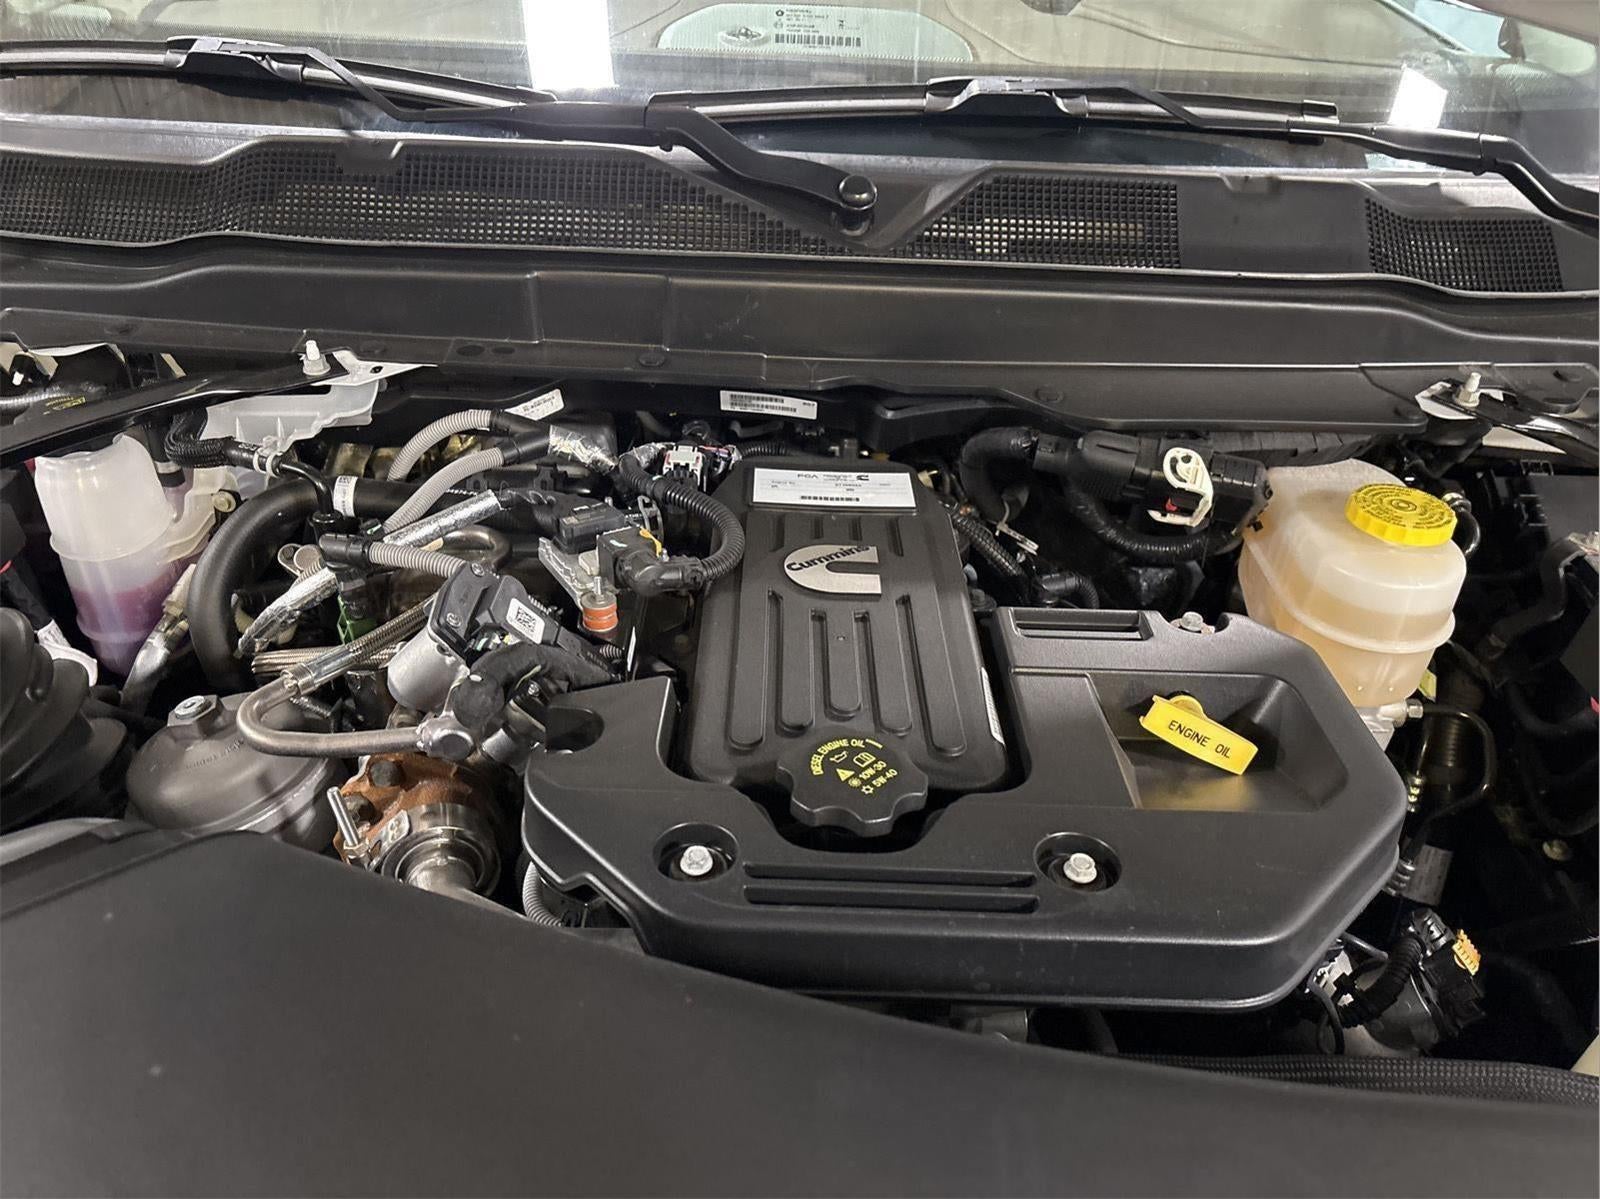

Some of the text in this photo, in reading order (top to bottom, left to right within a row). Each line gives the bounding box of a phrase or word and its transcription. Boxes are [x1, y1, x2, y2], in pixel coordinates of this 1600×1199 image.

[786, 546, 870, 571] Cummins
[817, 739, 849, 754] ENGINE
[850, 739, 865, 748] OIL
[1169, 720, 1232, 758] ENGINE OIL
[872, 768, 898, 787] 5W-40
